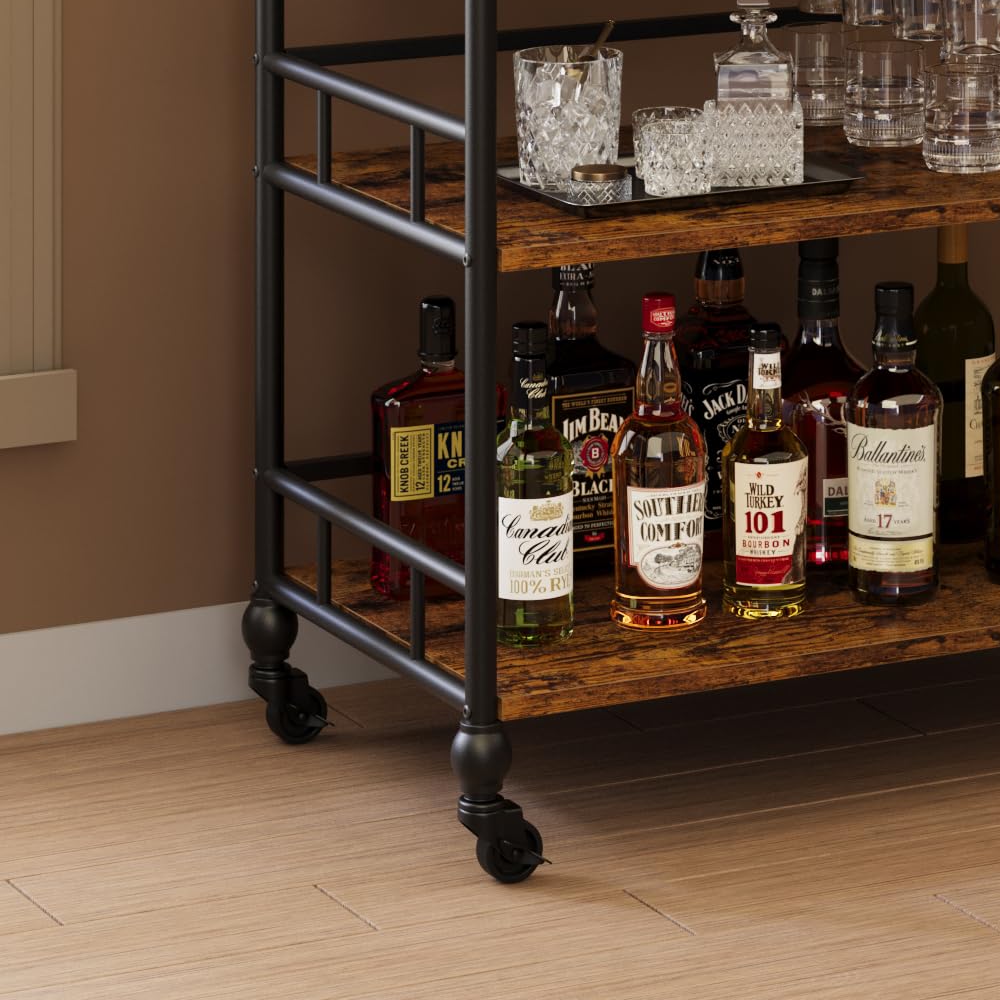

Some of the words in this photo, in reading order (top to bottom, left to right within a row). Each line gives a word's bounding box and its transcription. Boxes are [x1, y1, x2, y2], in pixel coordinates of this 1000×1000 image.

[702, 391, 736, 420] JACK
[563, 413, 587, 443] JIM
[400, 435, 409, 466] CREEK
[438, 431, 464, 460] KN
[400, 467, 409, 493] KNOB
[416, 481, 426, 491] 12
[437, 473, 451, 493] 12
[749, 482, 775, 496] WILD
[745, 492, 784, 510] TURKEY
[745, 510, 786, 534] 101
[877, 513, 893, 529] 17
[742, 538, 790, 549] BOURBON
[509, 579, 547, 594] 100%
